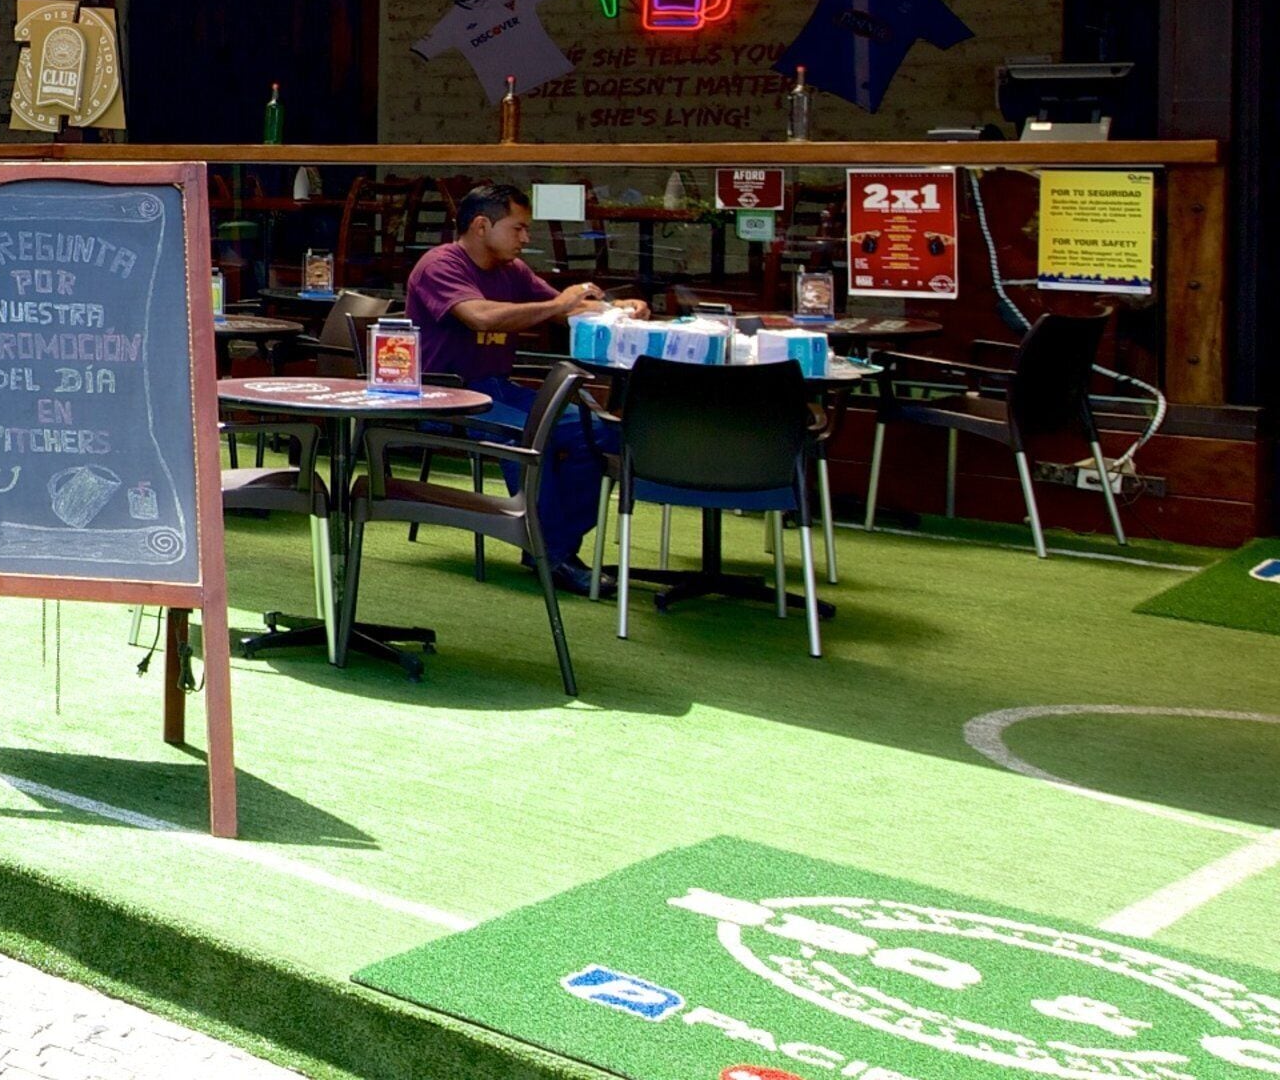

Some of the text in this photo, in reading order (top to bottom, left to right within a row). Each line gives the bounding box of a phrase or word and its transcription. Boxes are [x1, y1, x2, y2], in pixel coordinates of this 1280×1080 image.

[470, 17, 520, 48] DISCOVER
[593, 45, 638, 69] SHE
[645, 43, 721, 67] TELLS
[732, 42, 785, 65] YOU
[43, 69, 77, 86] CLUB
[583, 74, 690, 99] DOESN'T
[591, 105, 750, 129] SHE'S LYING!
[863, 183, 941, 209] 2x1
[1050, 188, 1142, 198] POR TU SEGURIDAD
[1052, 237, 1138, 249] FOR YOUR SAFETY
[11, 269, 76, 295] POR
[54, 365, 116, 393] DÍA
[37, 399, 73, 425] EN
